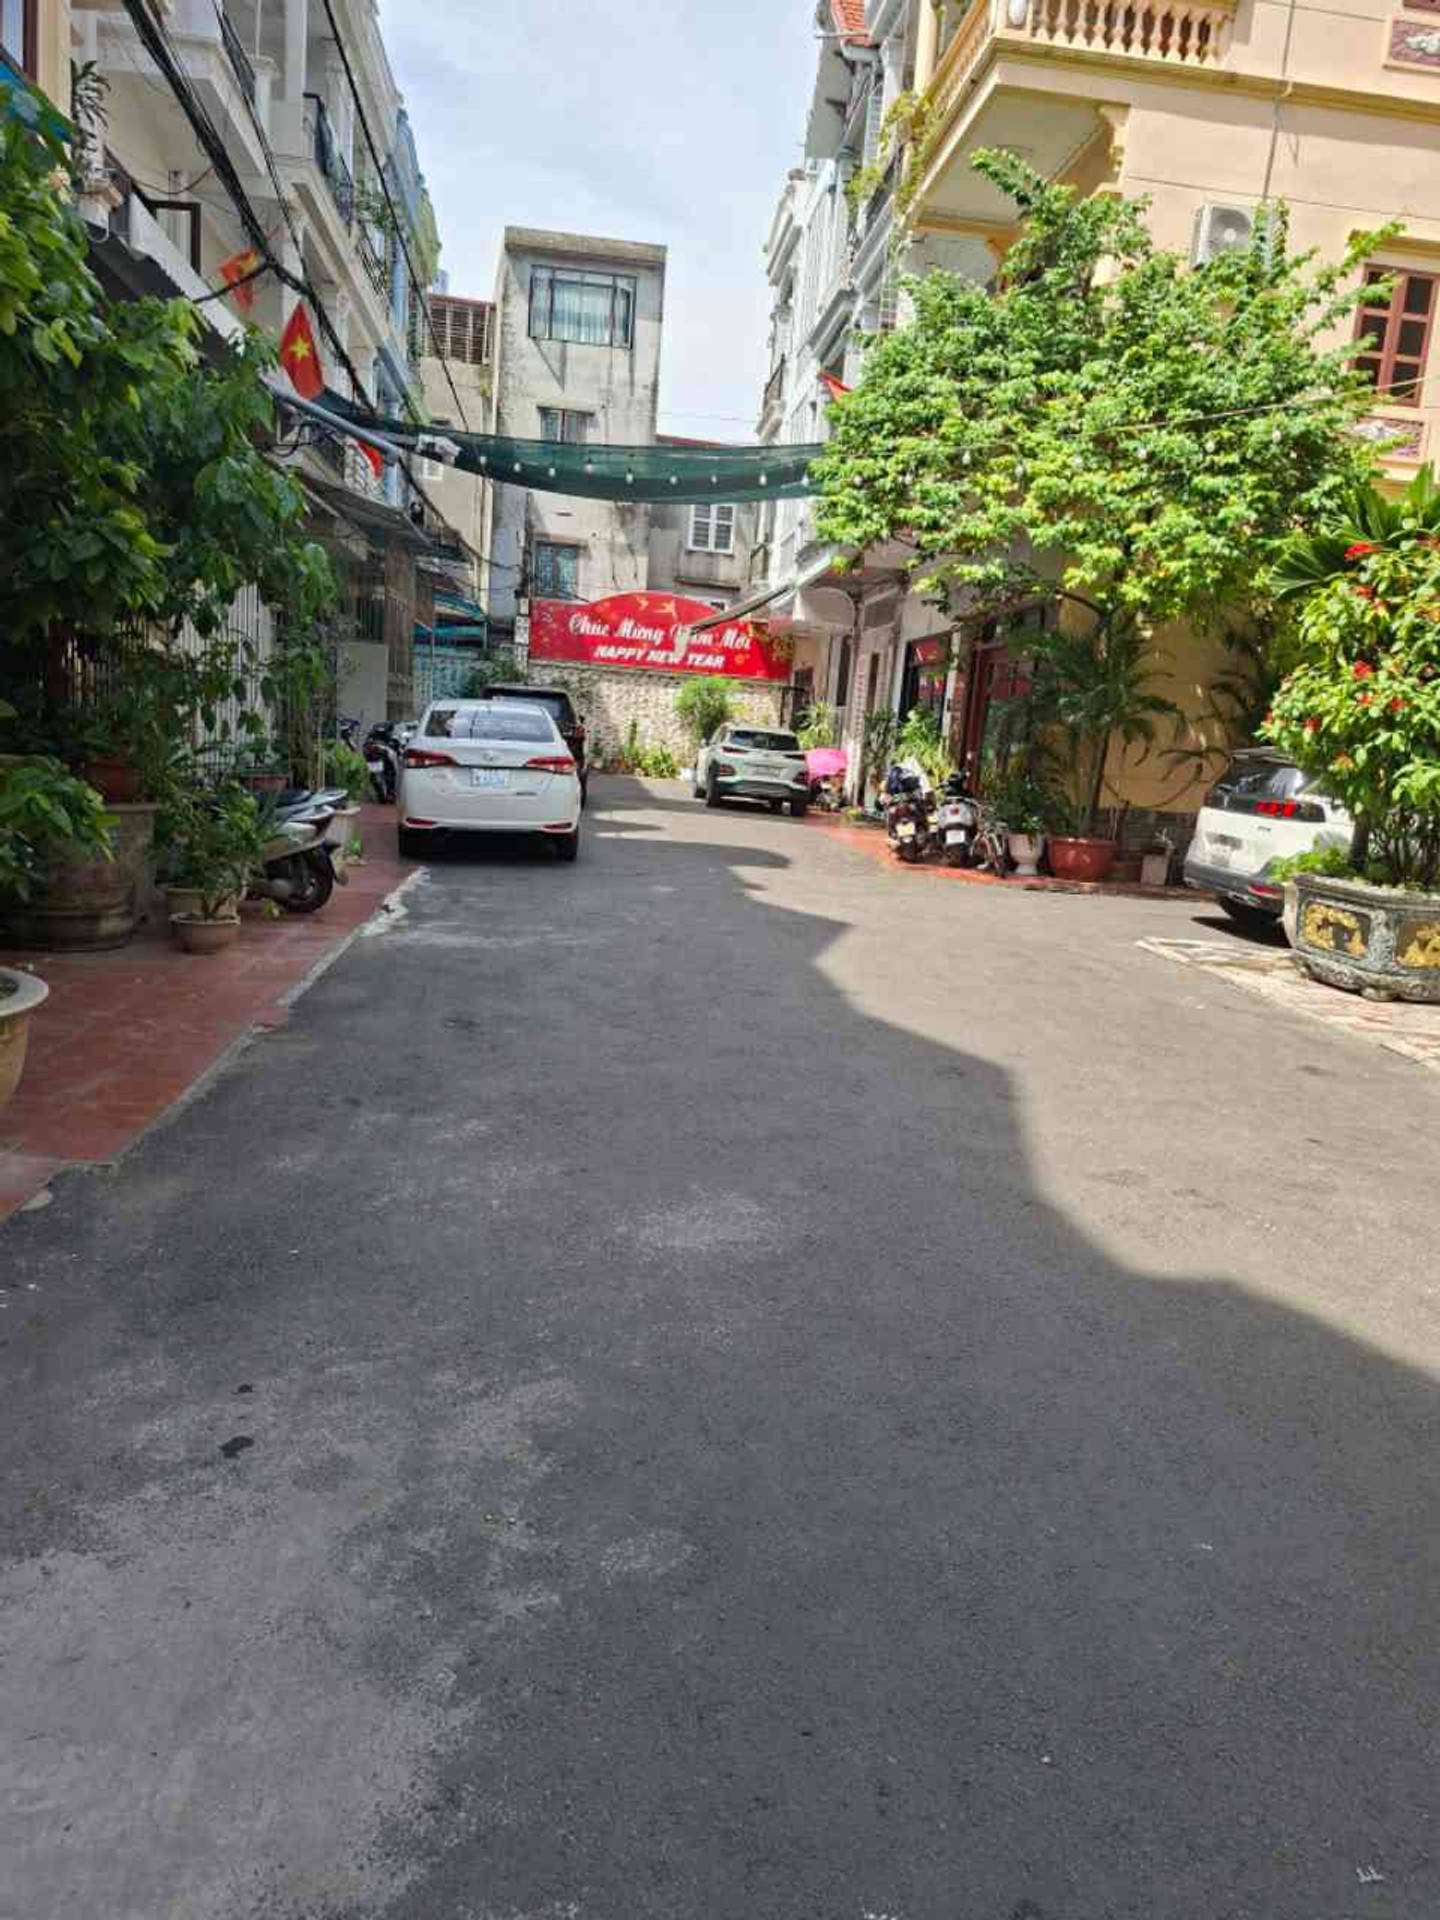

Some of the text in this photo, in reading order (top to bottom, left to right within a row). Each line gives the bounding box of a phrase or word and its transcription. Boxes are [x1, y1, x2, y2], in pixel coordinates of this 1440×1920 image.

[594, 645, 726, 669] HAPPY NEW YEAR
